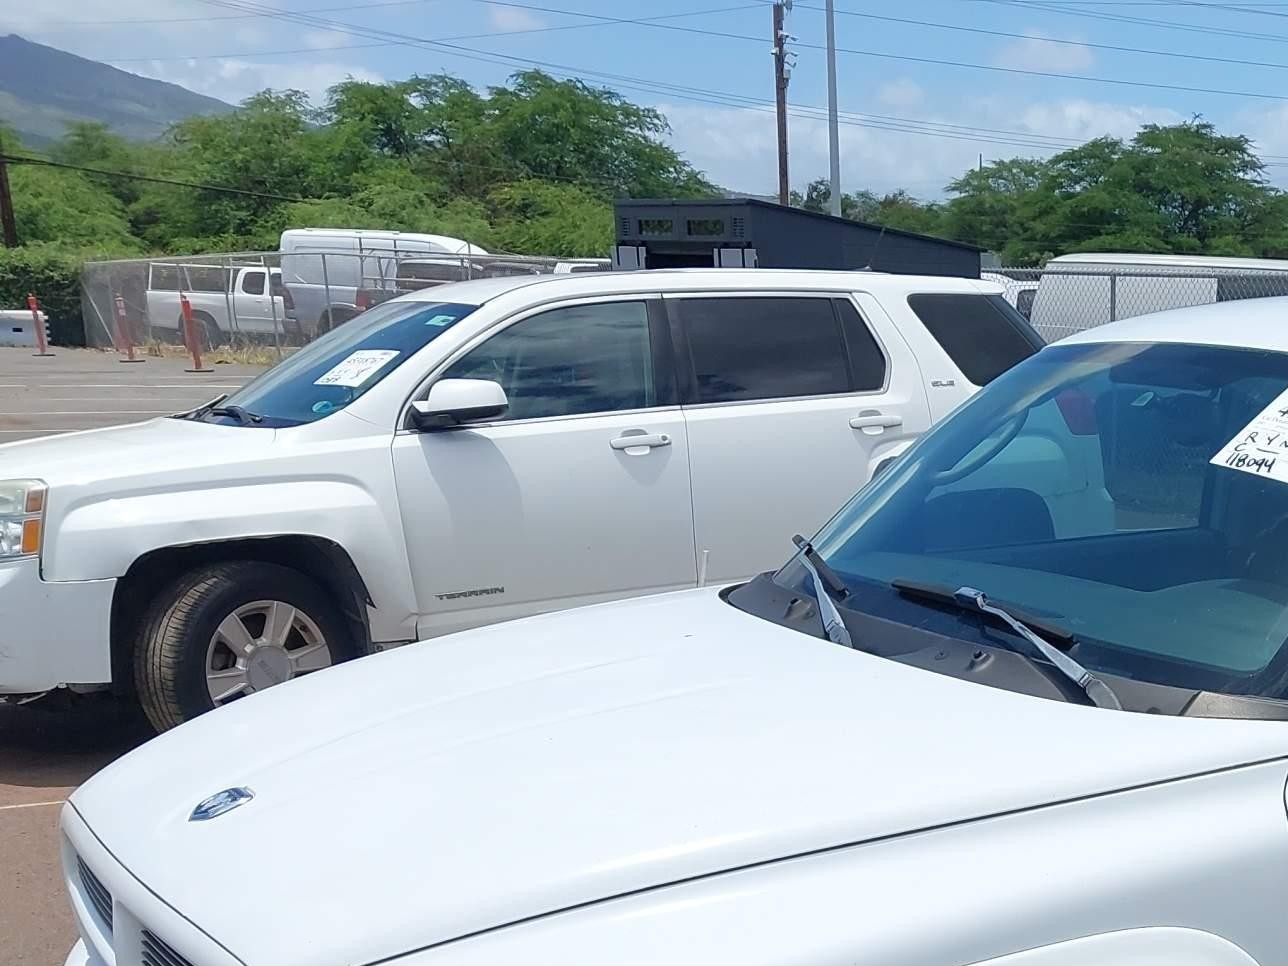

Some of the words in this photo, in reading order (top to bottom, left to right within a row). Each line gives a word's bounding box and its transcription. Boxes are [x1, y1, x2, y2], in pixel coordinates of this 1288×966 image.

[1244, 431, 1259, 443] R
[1267, 433, 1280, 445] Y
[1225, 452, 1277, 473] 118094
[433, 586, 505, 600] TERRAIN
